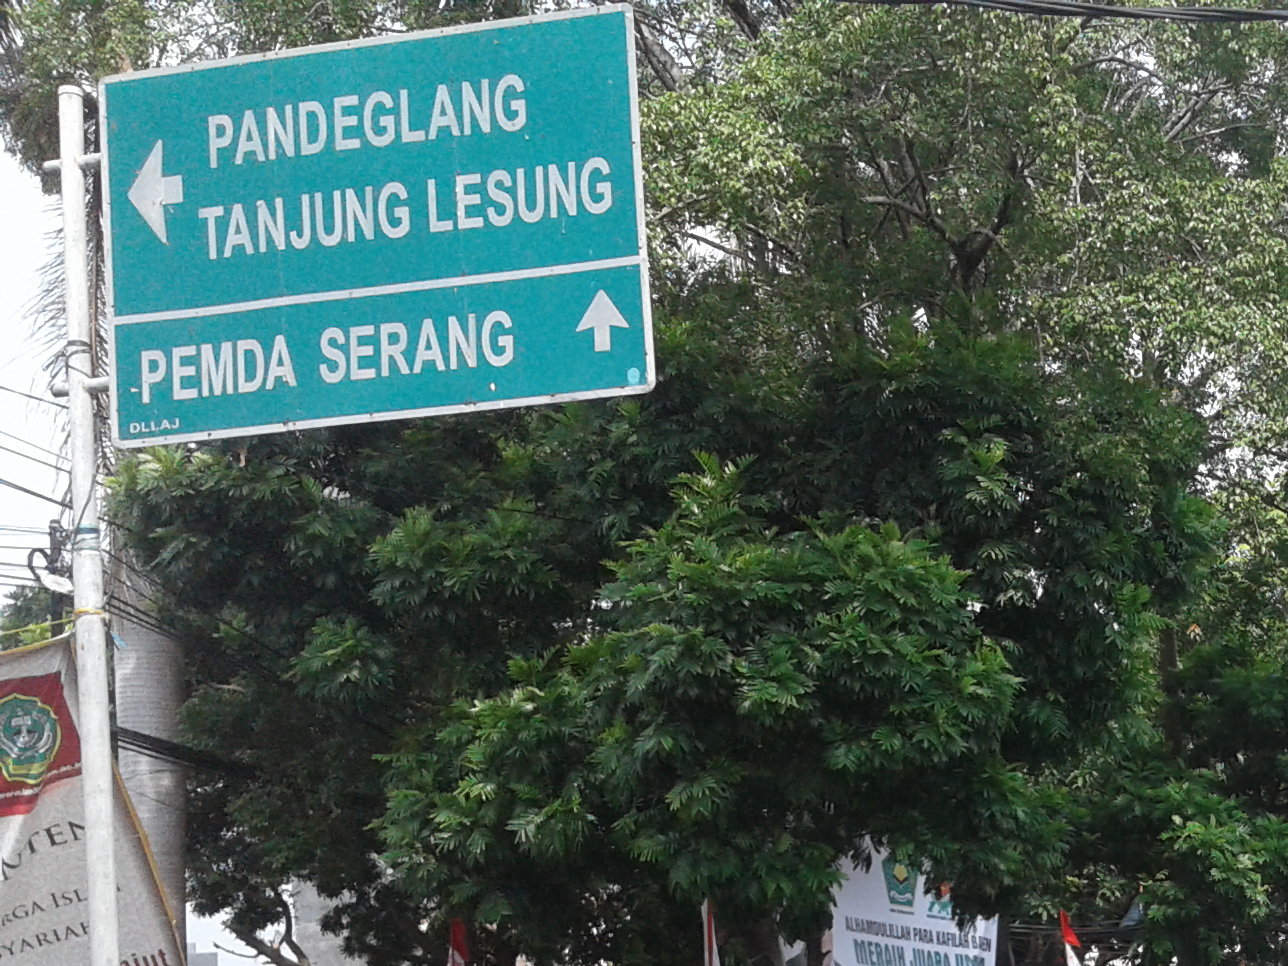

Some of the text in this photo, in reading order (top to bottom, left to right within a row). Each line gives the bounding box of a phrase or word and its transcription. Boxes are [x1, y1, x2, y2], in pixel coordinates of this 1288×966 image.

[208, 74, 528, 169] PANDEGLANG
[199, 156, 613, 260] TANJUNG LESUNG
[140, 310, 514, 404] PEMDA SERANG
[129, 418, 181, 434] DLLAJ
